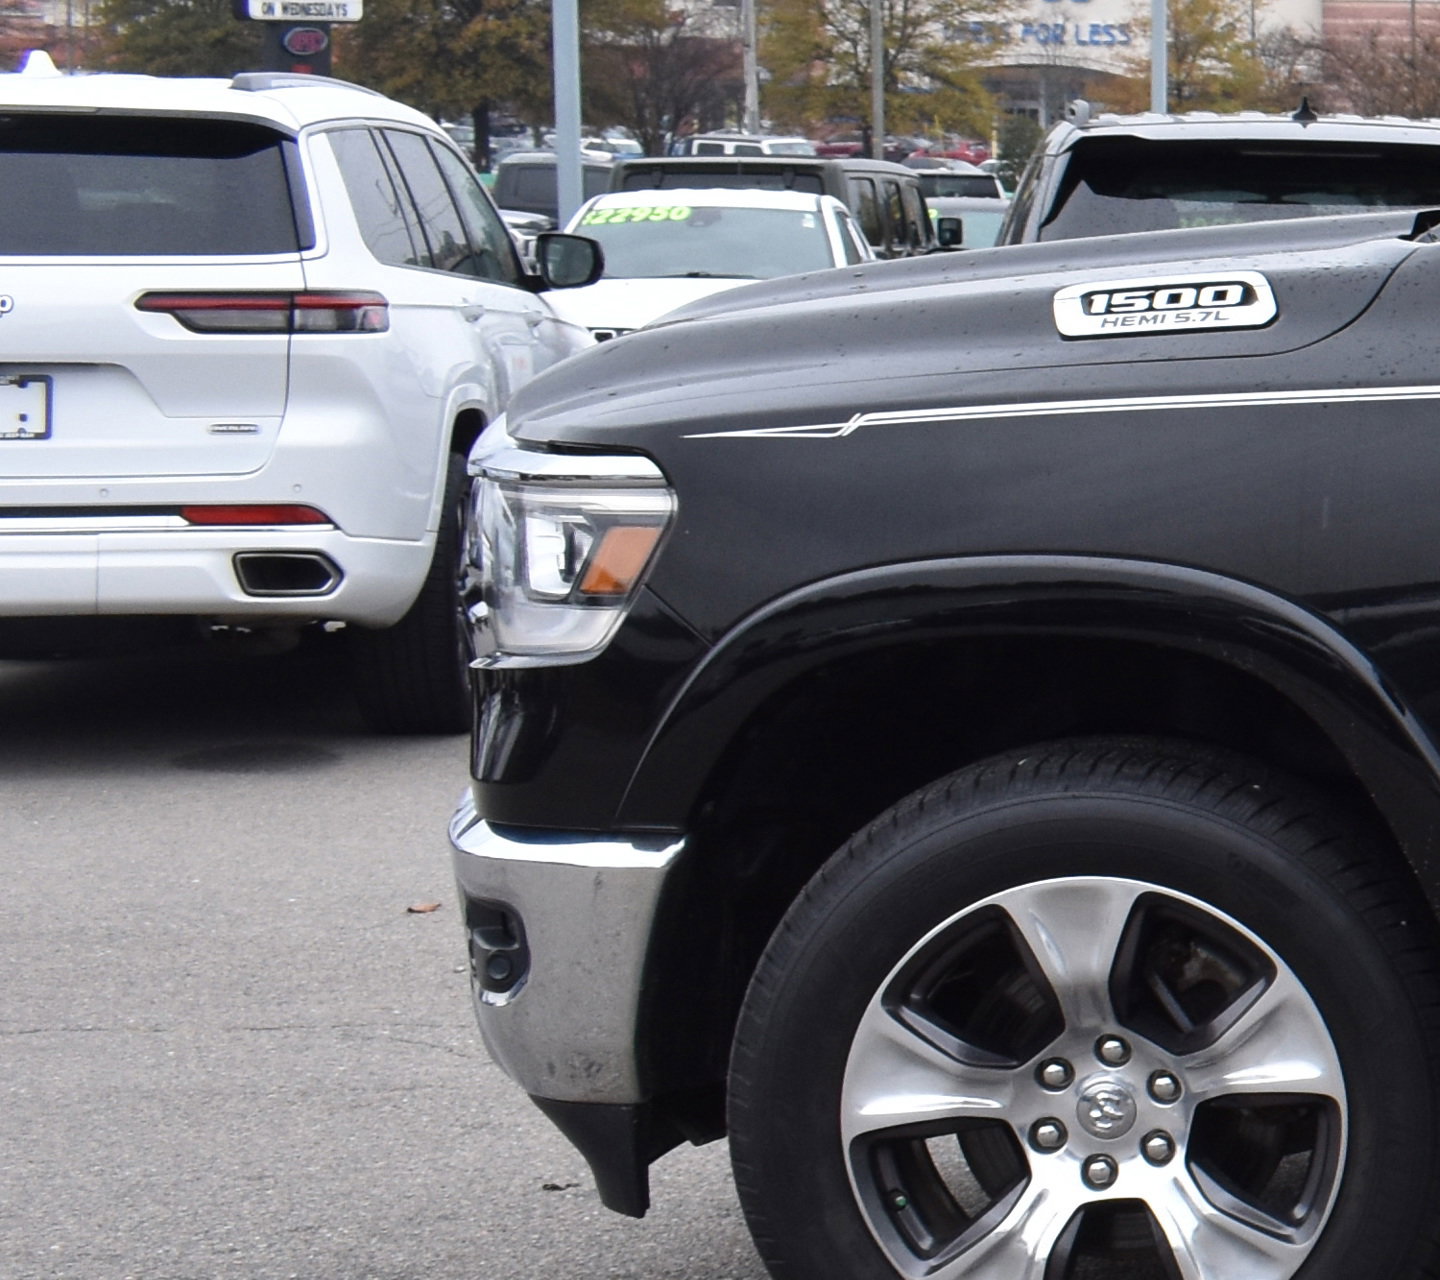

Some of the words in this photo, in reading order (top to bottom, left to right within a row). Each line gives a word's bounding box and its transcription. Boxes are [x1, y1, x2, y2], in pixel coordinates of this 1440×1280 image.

[261, 2, 275, 16] ON
[281, 2, 348, 17] WEDNESDAYS
[1076, 23, 1132, 46] LESS
[1090, 284, 1244, 314] 1500
[1101, 313, 1166, 329] HEMI
[1174, 310, 1230, 325] 5.7L
